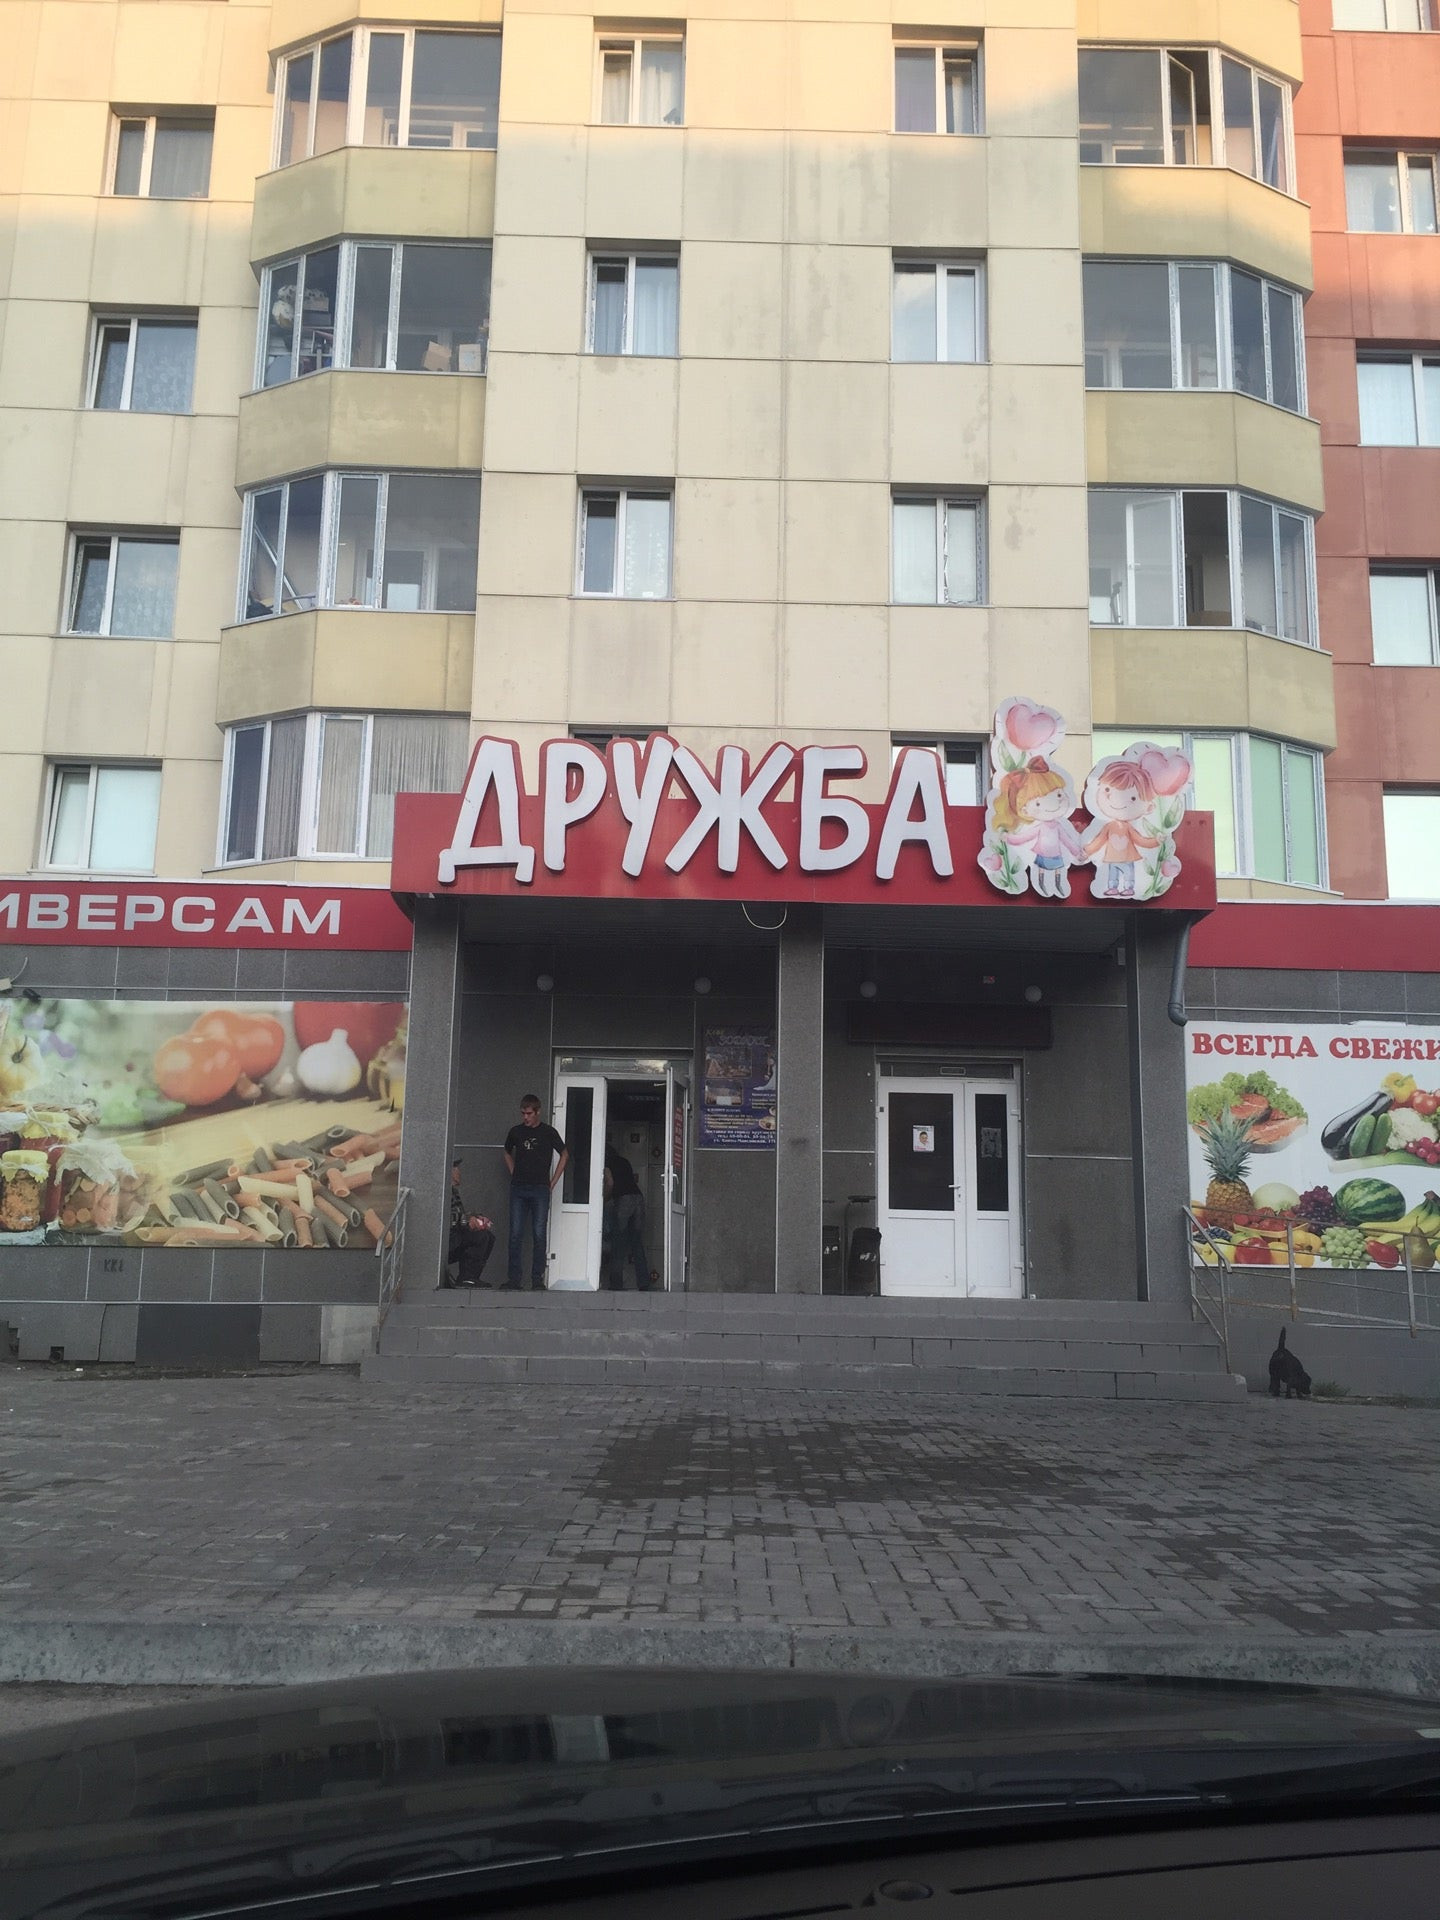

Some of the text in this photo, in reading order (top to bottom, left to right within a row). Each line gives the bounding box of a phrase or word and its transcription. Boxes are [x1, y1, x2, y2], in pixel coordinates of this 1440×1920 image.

[437, 732, 954, 883] ДРУЖБА
[1192, 1033, 1440, 1060] ВСЕГДА СВЕЖИ
